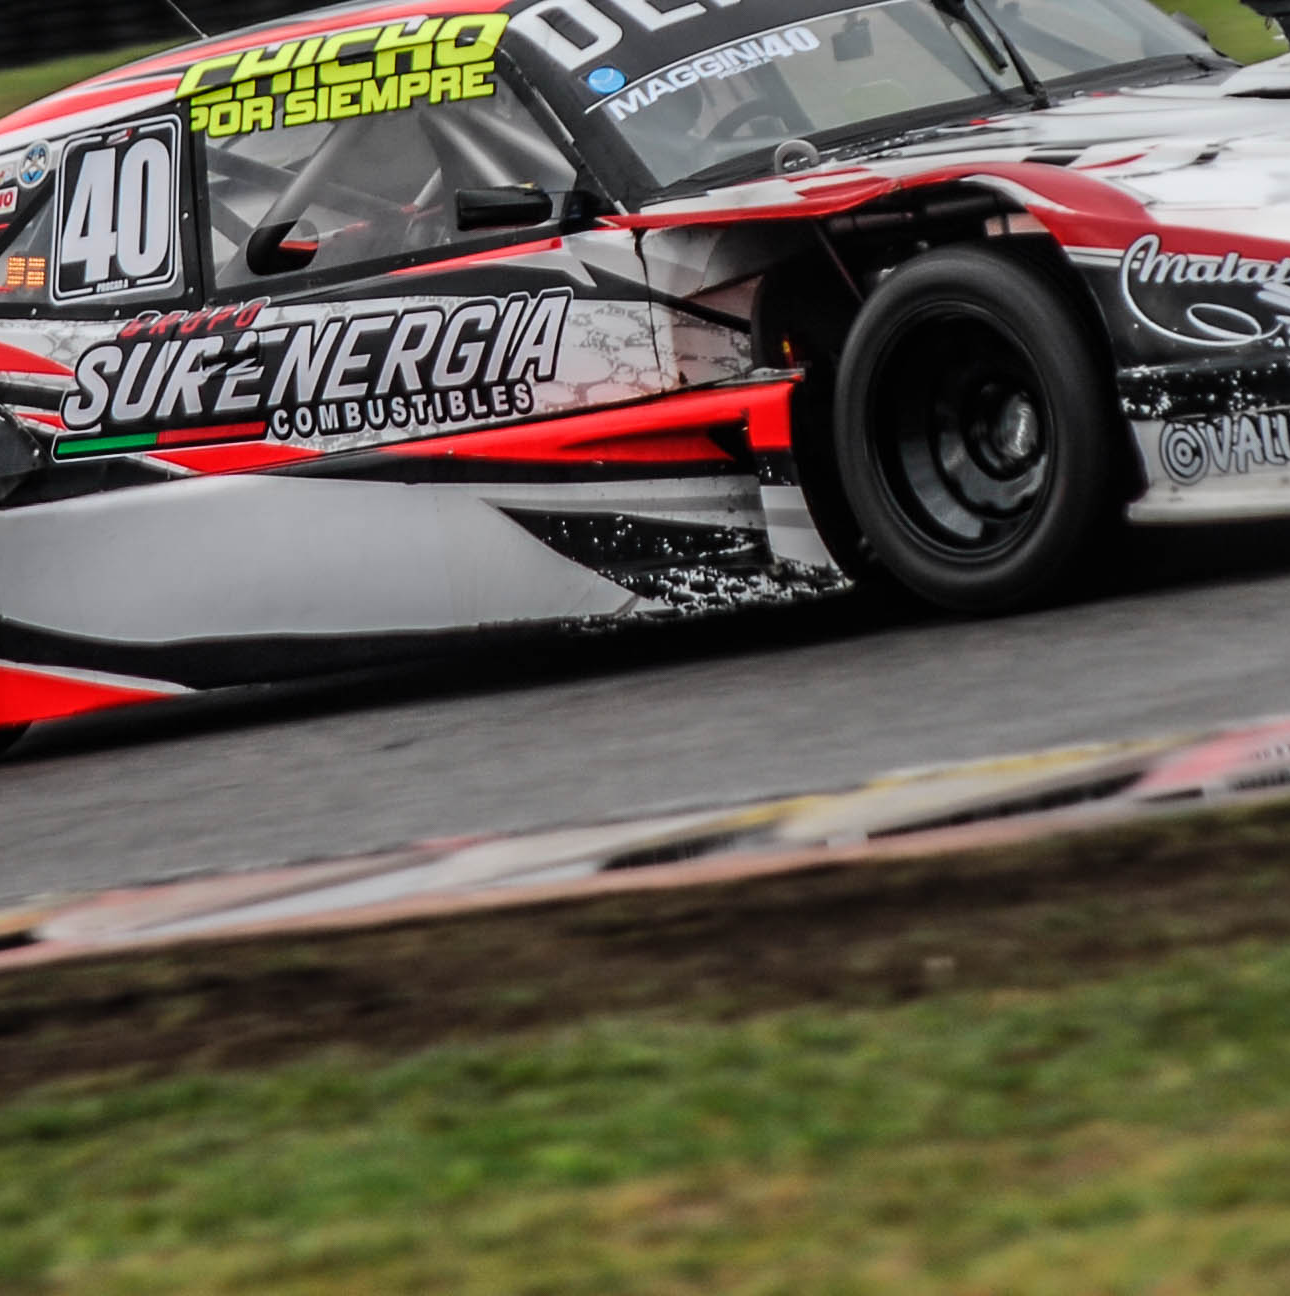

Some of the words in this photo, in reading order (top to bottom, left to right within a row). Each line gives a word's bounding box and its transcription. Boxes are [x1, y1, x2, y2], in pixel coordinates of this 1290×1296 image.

[175, 13, 511, 105] CHICHO
[190, 96, 274, 138] POR
[282, 61, 496, 128] SIEMPRE
[61, 138, 171, 283] 40
[120, 299, 268, 337] GRUPO
[64, 295, 567, 428] SURENERGIA
[271, 384, 532, 435] COMBUSTIBLES
